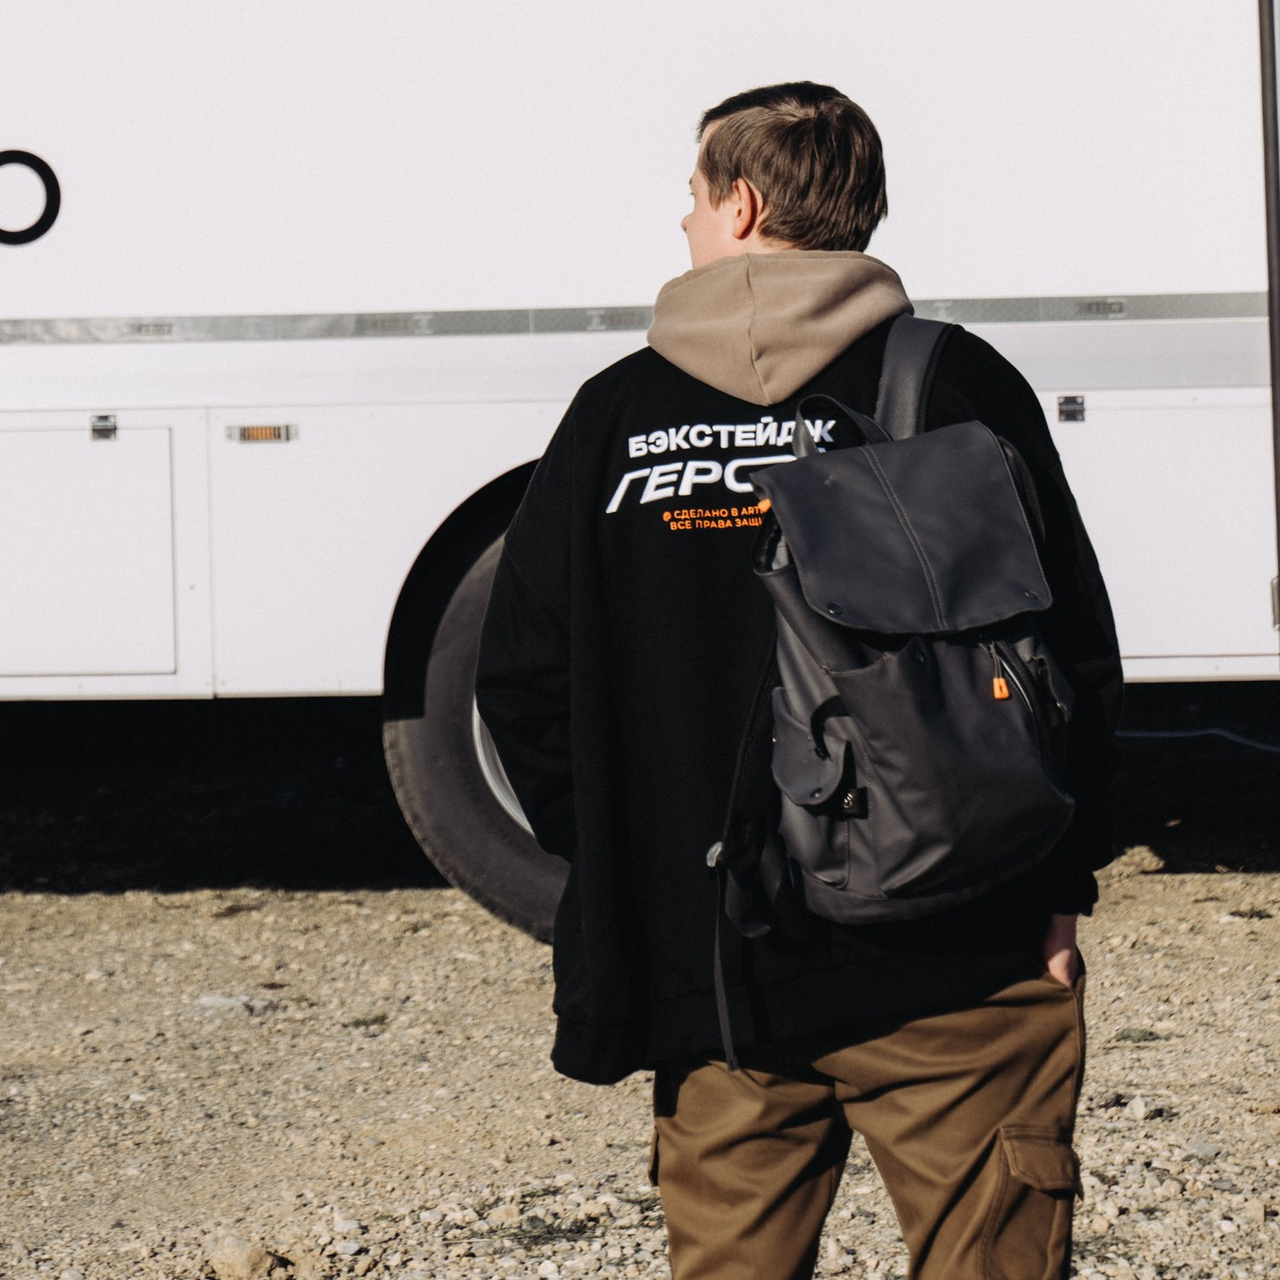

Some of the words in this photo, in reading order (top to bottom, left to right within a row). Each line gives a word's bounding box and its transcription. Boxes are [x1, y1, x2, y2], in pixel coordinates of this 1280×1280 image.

[673, 508, 728, 520] СДЕЛАНО
[731, 507, 738, 517] В
[670, 520, 693, 530] ВСЕ
[695, 519, 732, 529] ПРАВА
